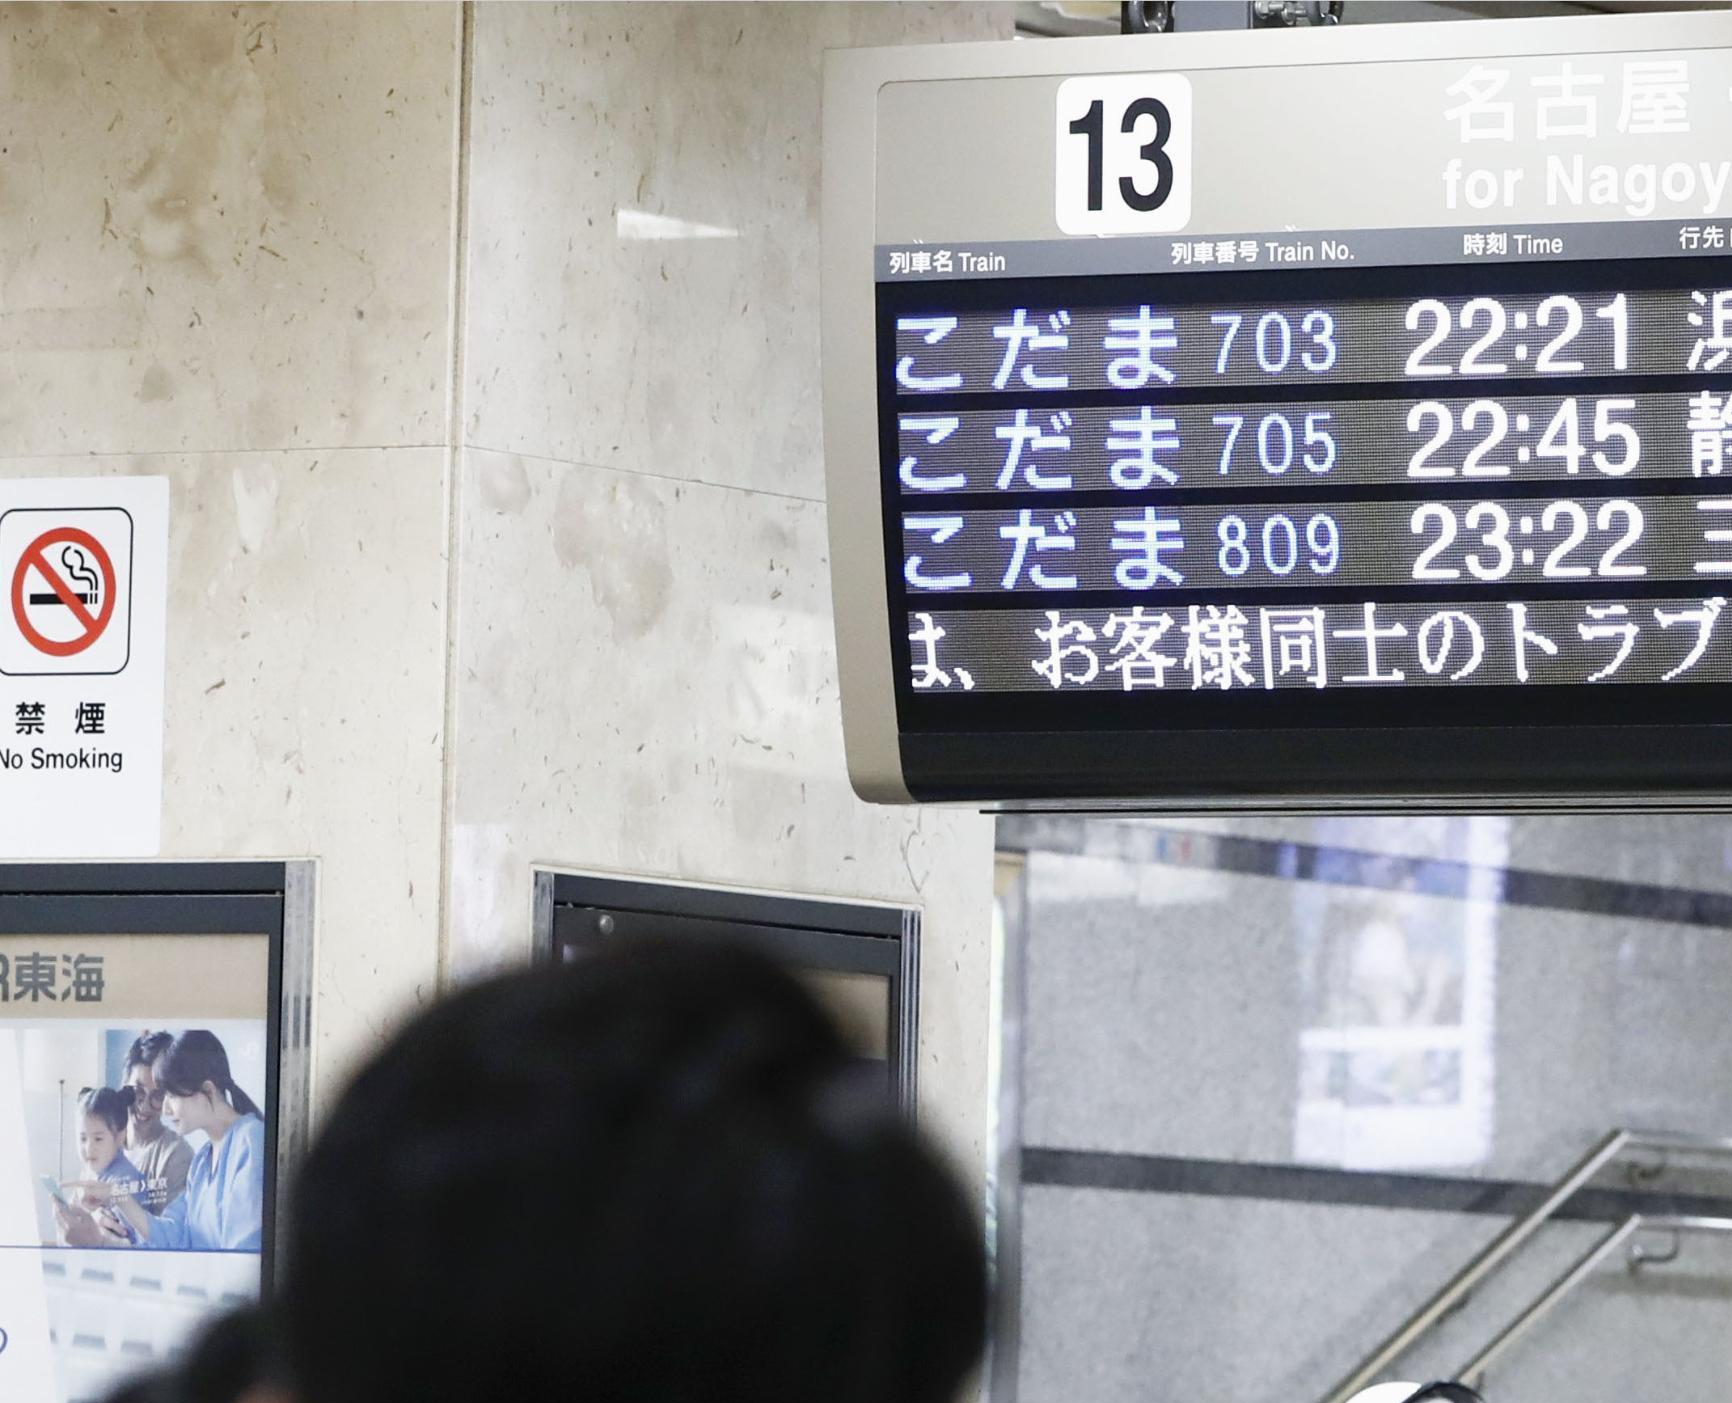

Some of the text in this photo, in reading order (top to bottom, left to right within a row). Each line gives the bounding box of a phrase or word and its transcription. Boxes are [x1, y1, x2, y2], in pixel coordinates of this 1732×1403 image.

[1070, 98, 1173, 212] 13
[1443, 158, 1523, 209] for
[1171, 240, 1355, 265] 列車番号 Train No.
[1463, 232, 1563, 256] 時刻 Time
[1679, 226, 1724, 250] 行先
[890, 250, 1005, 274] 列車名 Train
[895, 305, 1178, 390] こだま
[1210, 310, 1338, 374] 703
[1404, 293, 1627, 376] 22:21
[899, 405, 1181, 490] こだま
[1211, 412, 1338, 475] 705
[1407, 398, 1640, 478] 22:45
[904, 506, 1185, 591] こだま
[1216, 513, 1340, 577] 809
[1409, 499, 1647, 582] 23:22
[15, 701, 106, 736] 禁煙
[0, 747, 123, 773] No Smoking
